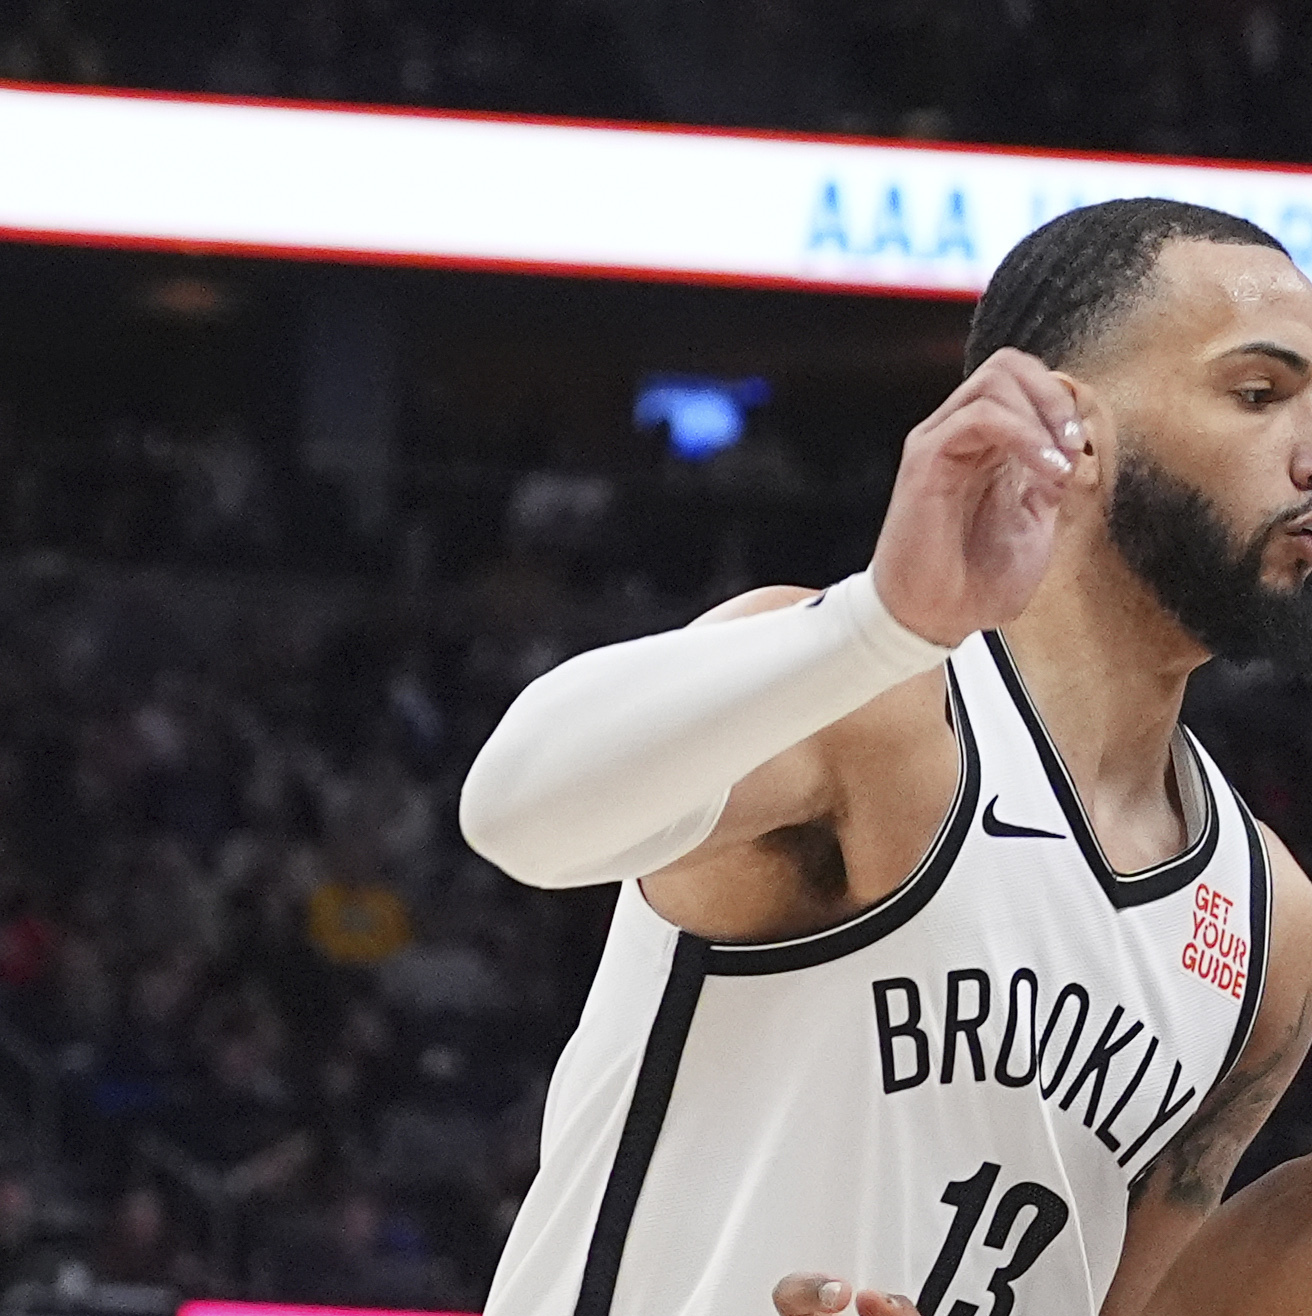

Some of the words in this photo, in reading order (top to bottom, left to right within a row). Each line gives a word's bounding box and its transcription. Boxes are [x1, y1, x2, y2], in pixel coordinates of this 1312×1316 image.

[803, 174, 981, 263] AAA
[1195, 883, 1234, 926] GET
[1193, 910, 1247, 968] YOUR
[1182, 941, 1246, 1000] GUIDE
[872, 967, 1197, 1168] BROOKLY
